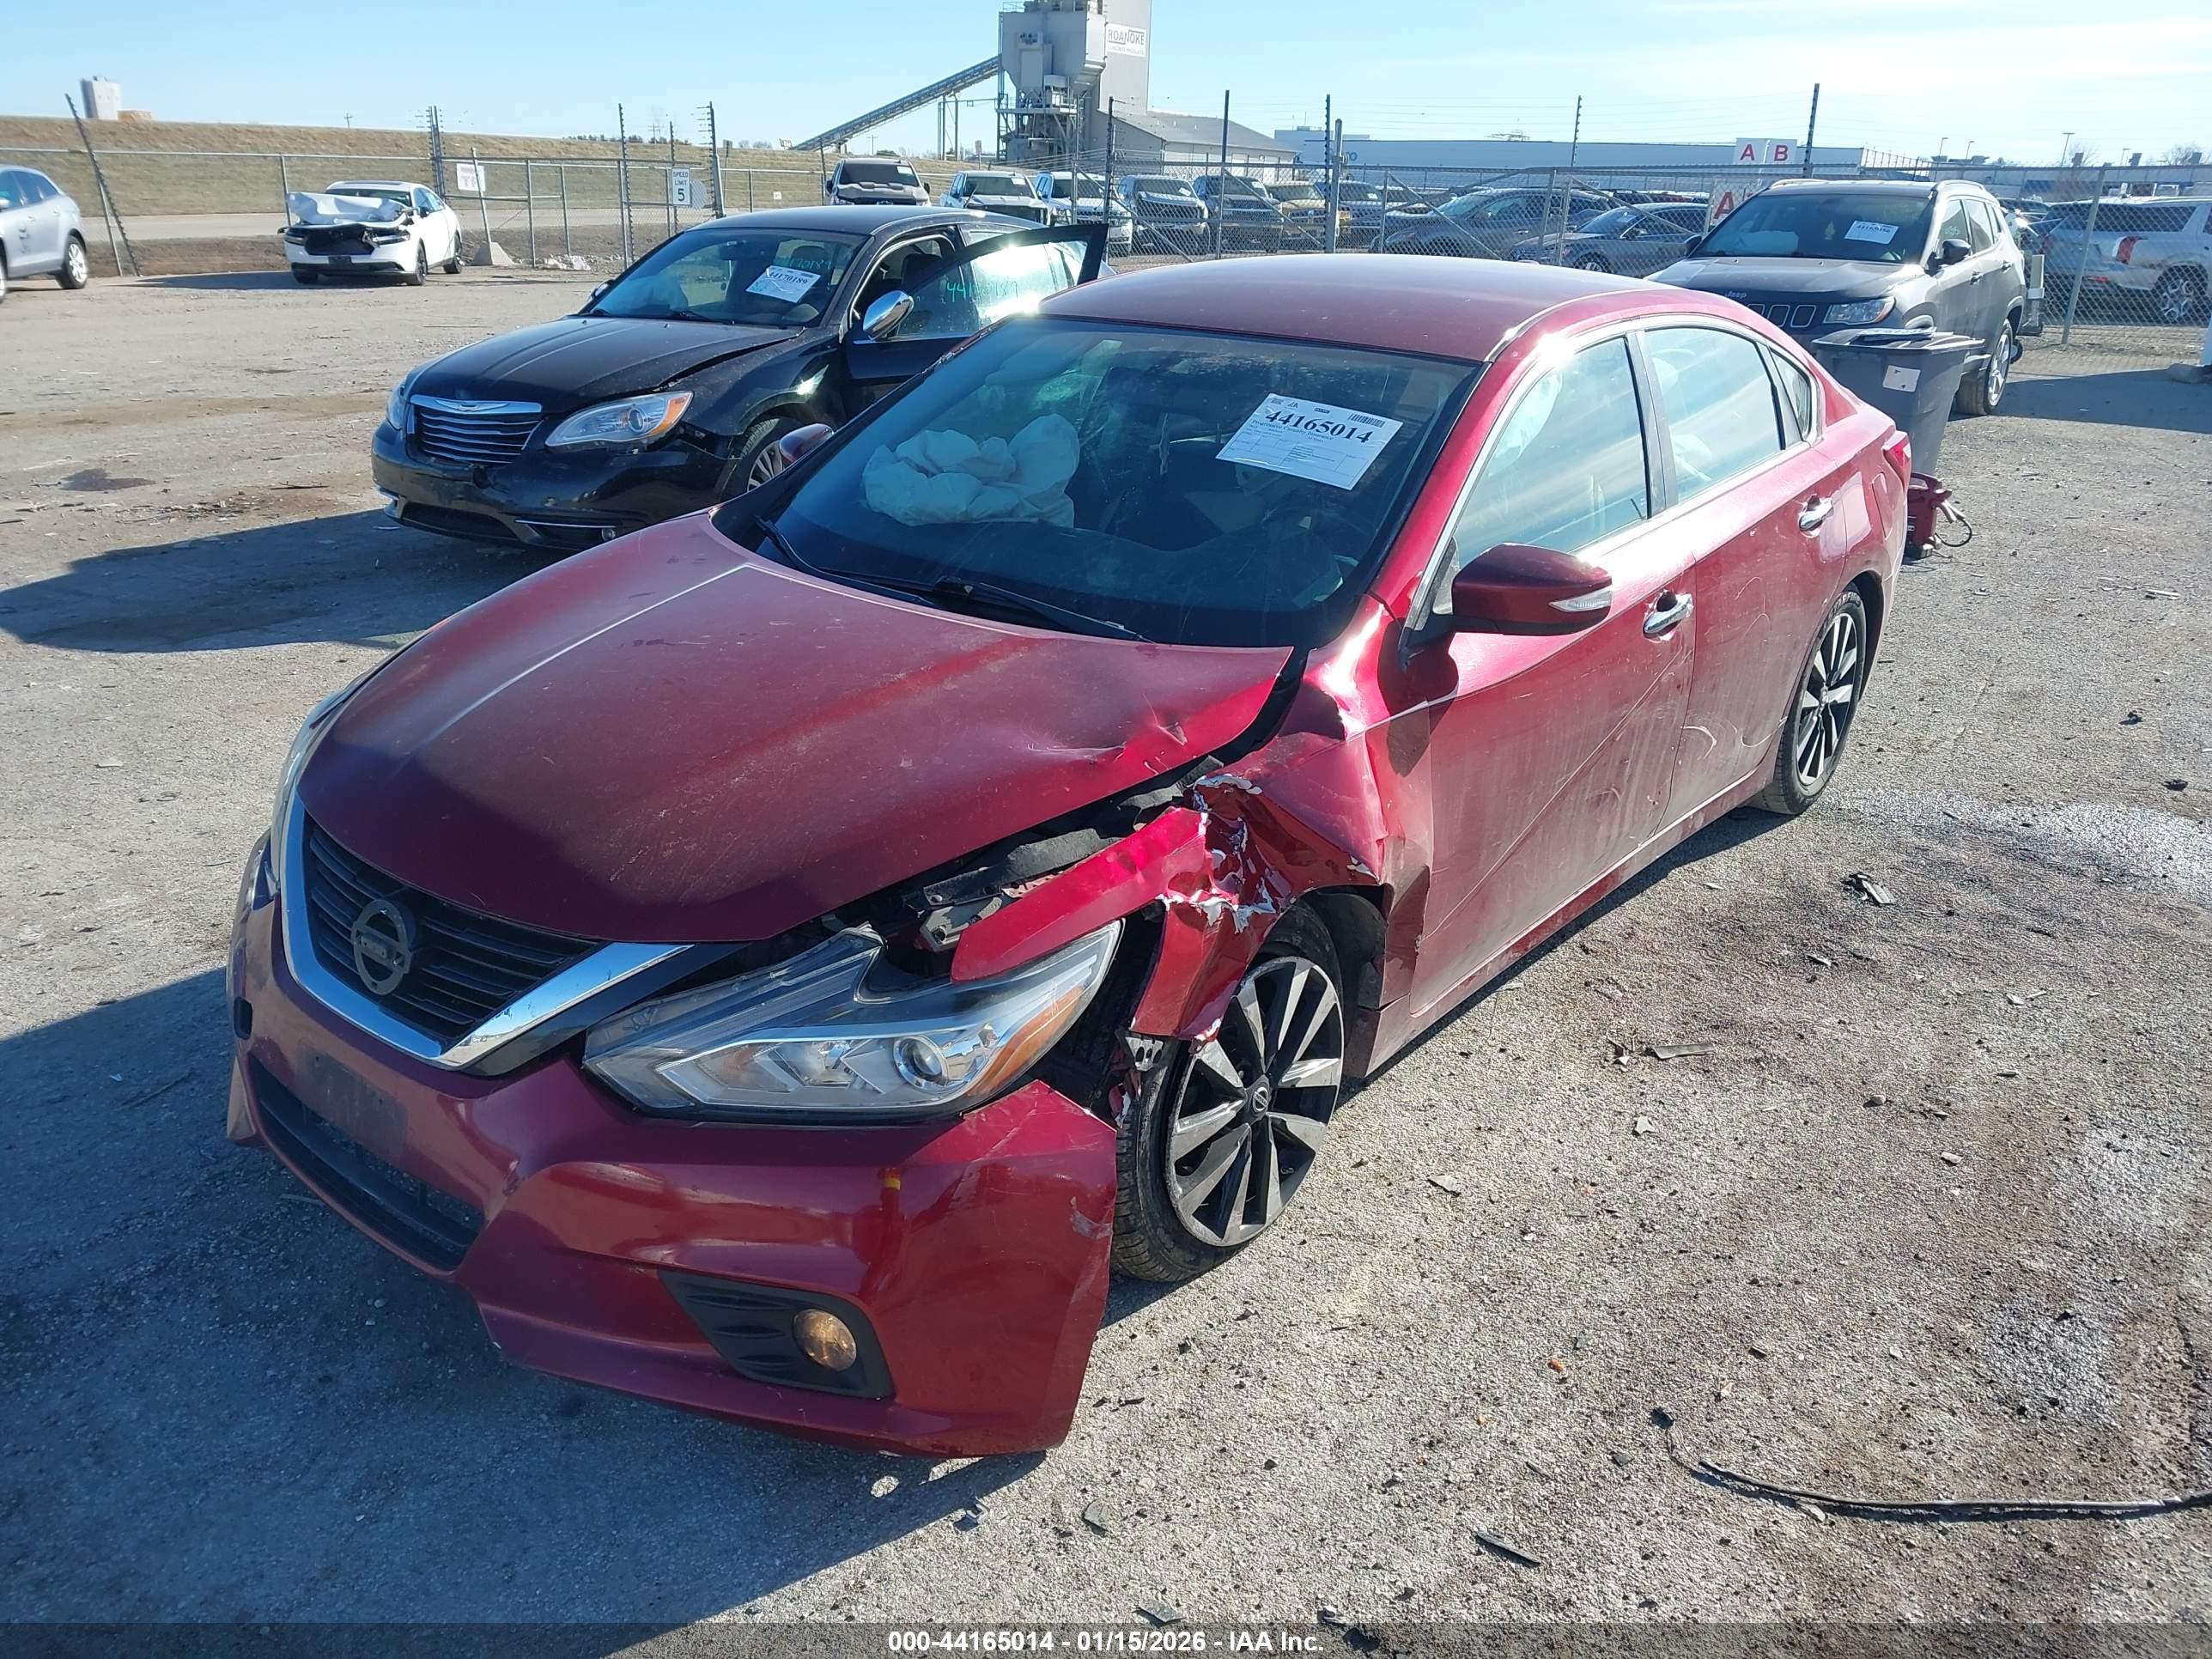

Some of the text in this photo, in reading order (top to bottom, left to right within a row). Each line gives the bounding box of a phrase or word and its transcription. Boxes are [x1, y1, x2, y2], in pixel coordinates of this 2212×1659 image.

[1108, 29, 1145, 45] ROANOKE
[1740, 143, 1789, 161] A B
[678, 188, 685, 201] 5
[1714, 191, 1735, 219] A
[1726, 290, 1747, 299] Jeep
[1265, 411, 1373, 443] 44165014
